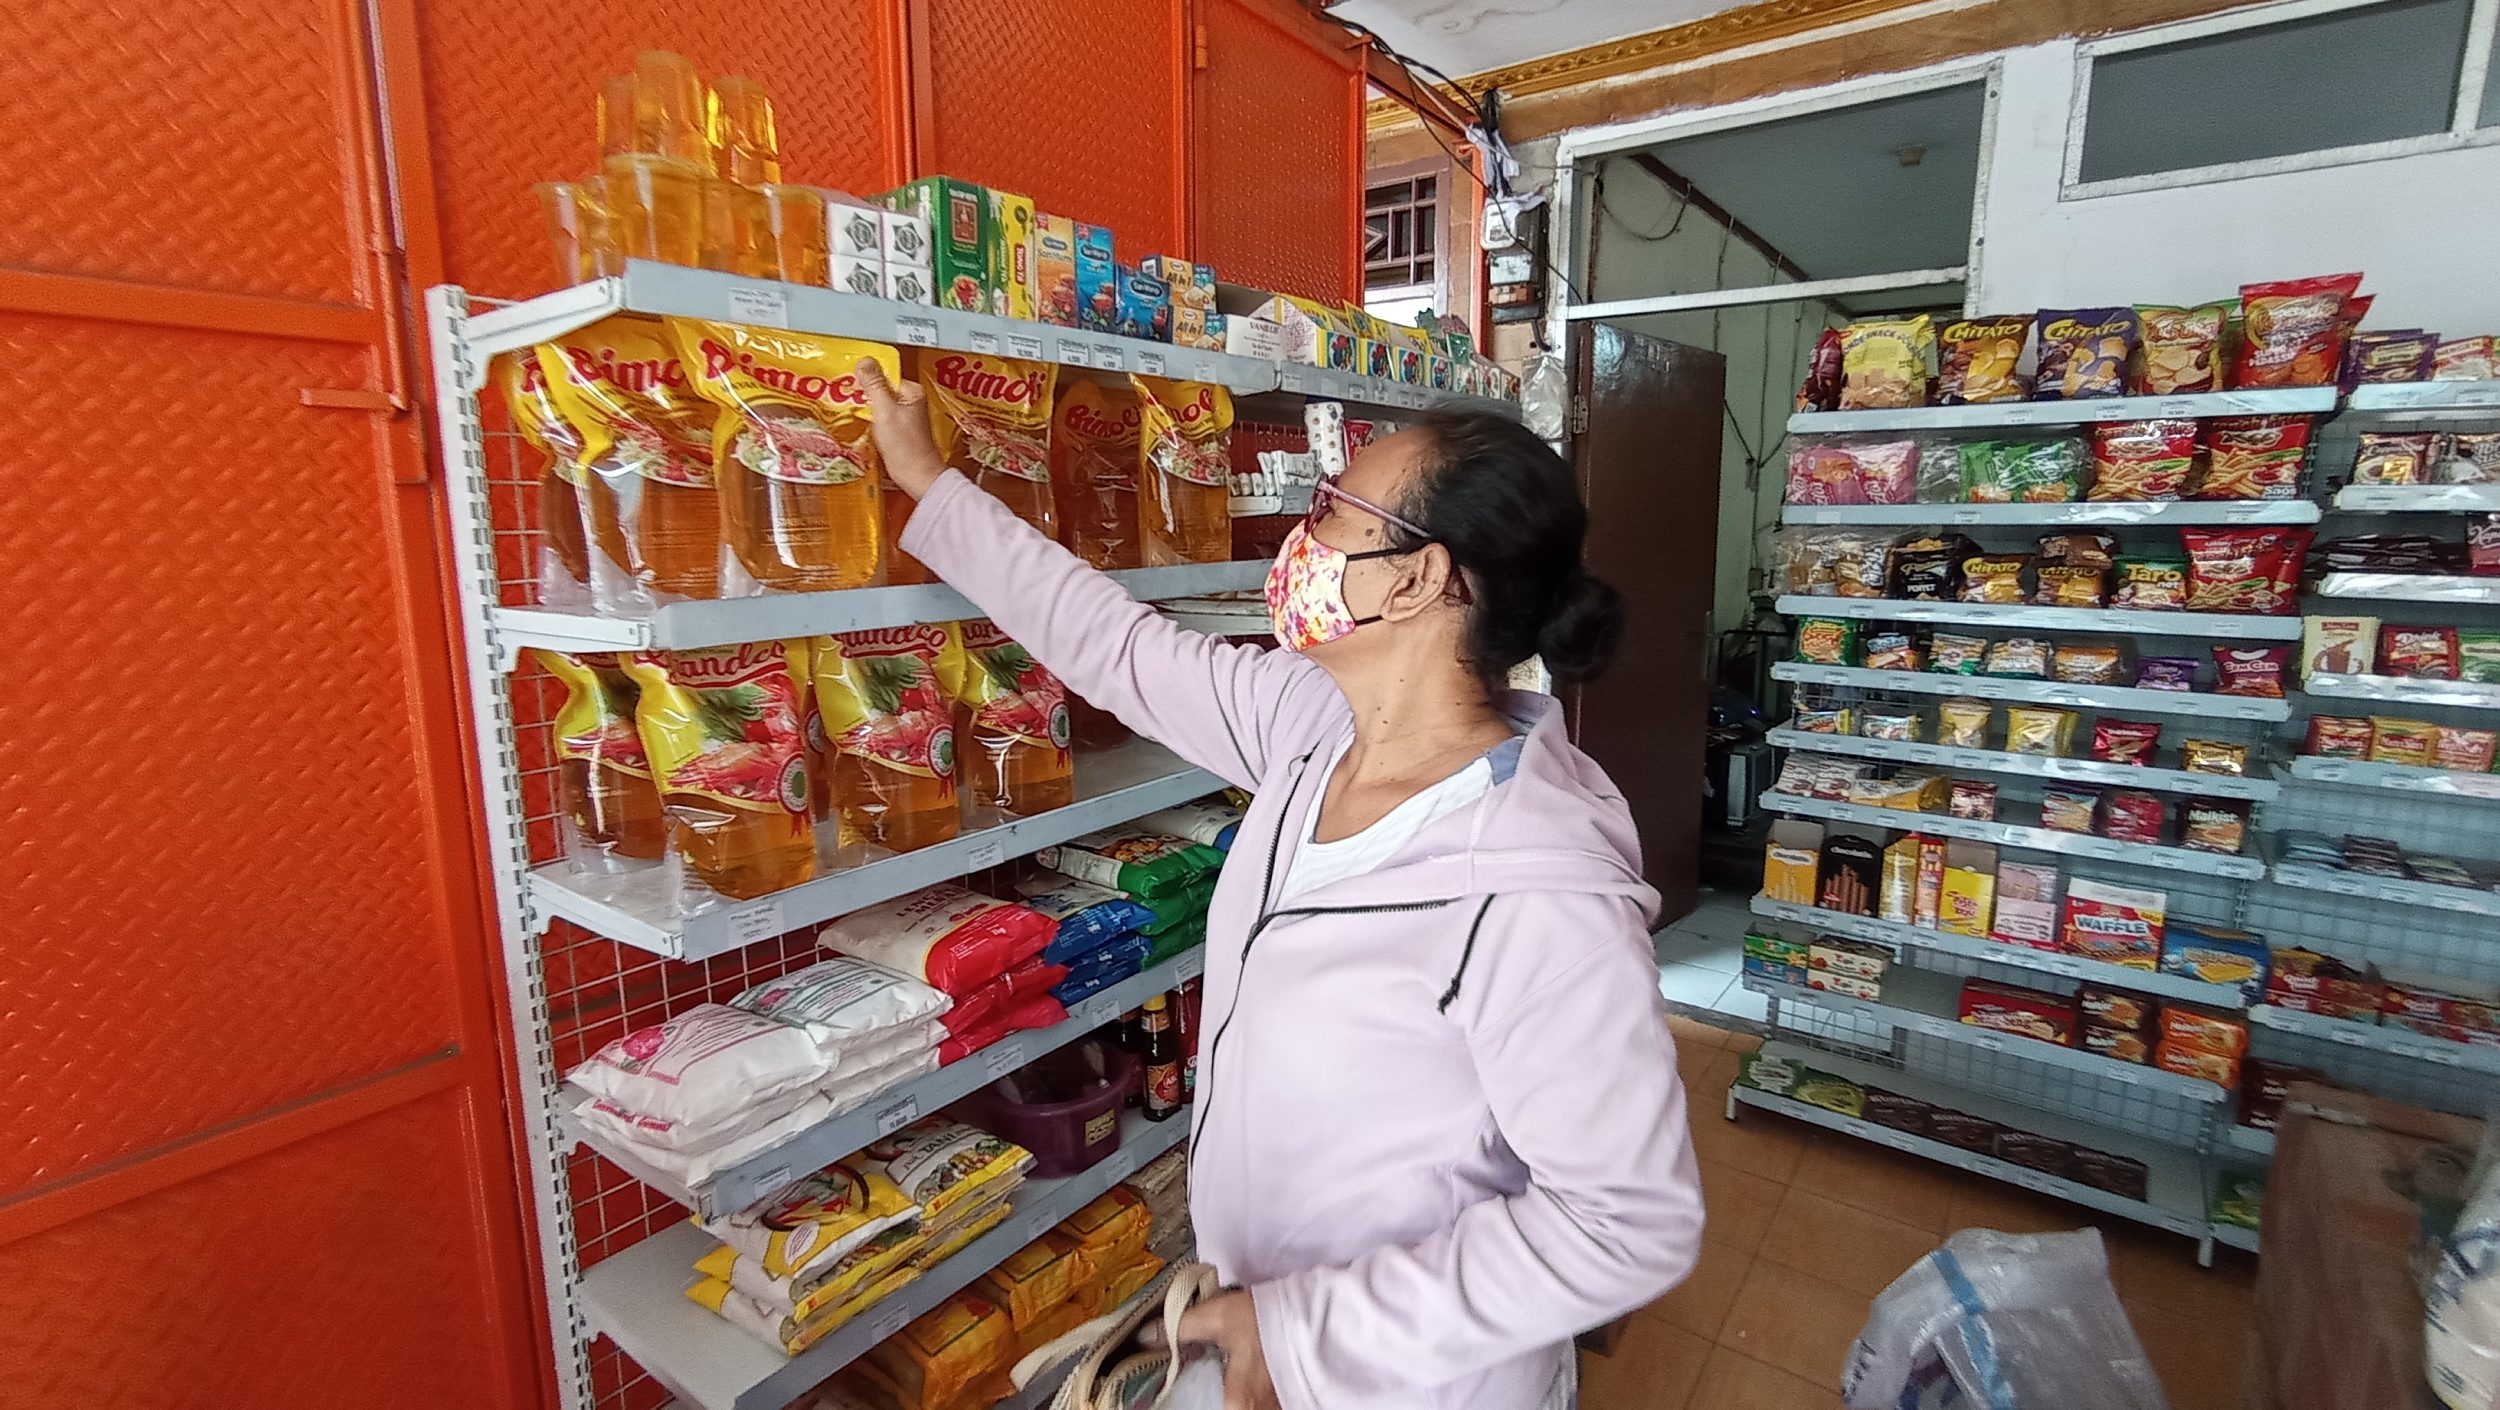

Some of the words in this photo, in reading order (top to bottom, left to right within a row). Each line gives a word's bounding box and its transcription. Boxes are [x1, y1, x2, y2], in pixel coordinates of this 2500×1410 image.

[1944, 321, 2023, 342] CHITATO
[2044, 319, 2133, 341] CHITATO
[935, 355, 1046, 408] Bimoli
[2126, 563, 2184, 583] Taro
[2188, 809, 2238, 822] Malkist
[2076, 915, 2147, 934] WAFFLE
